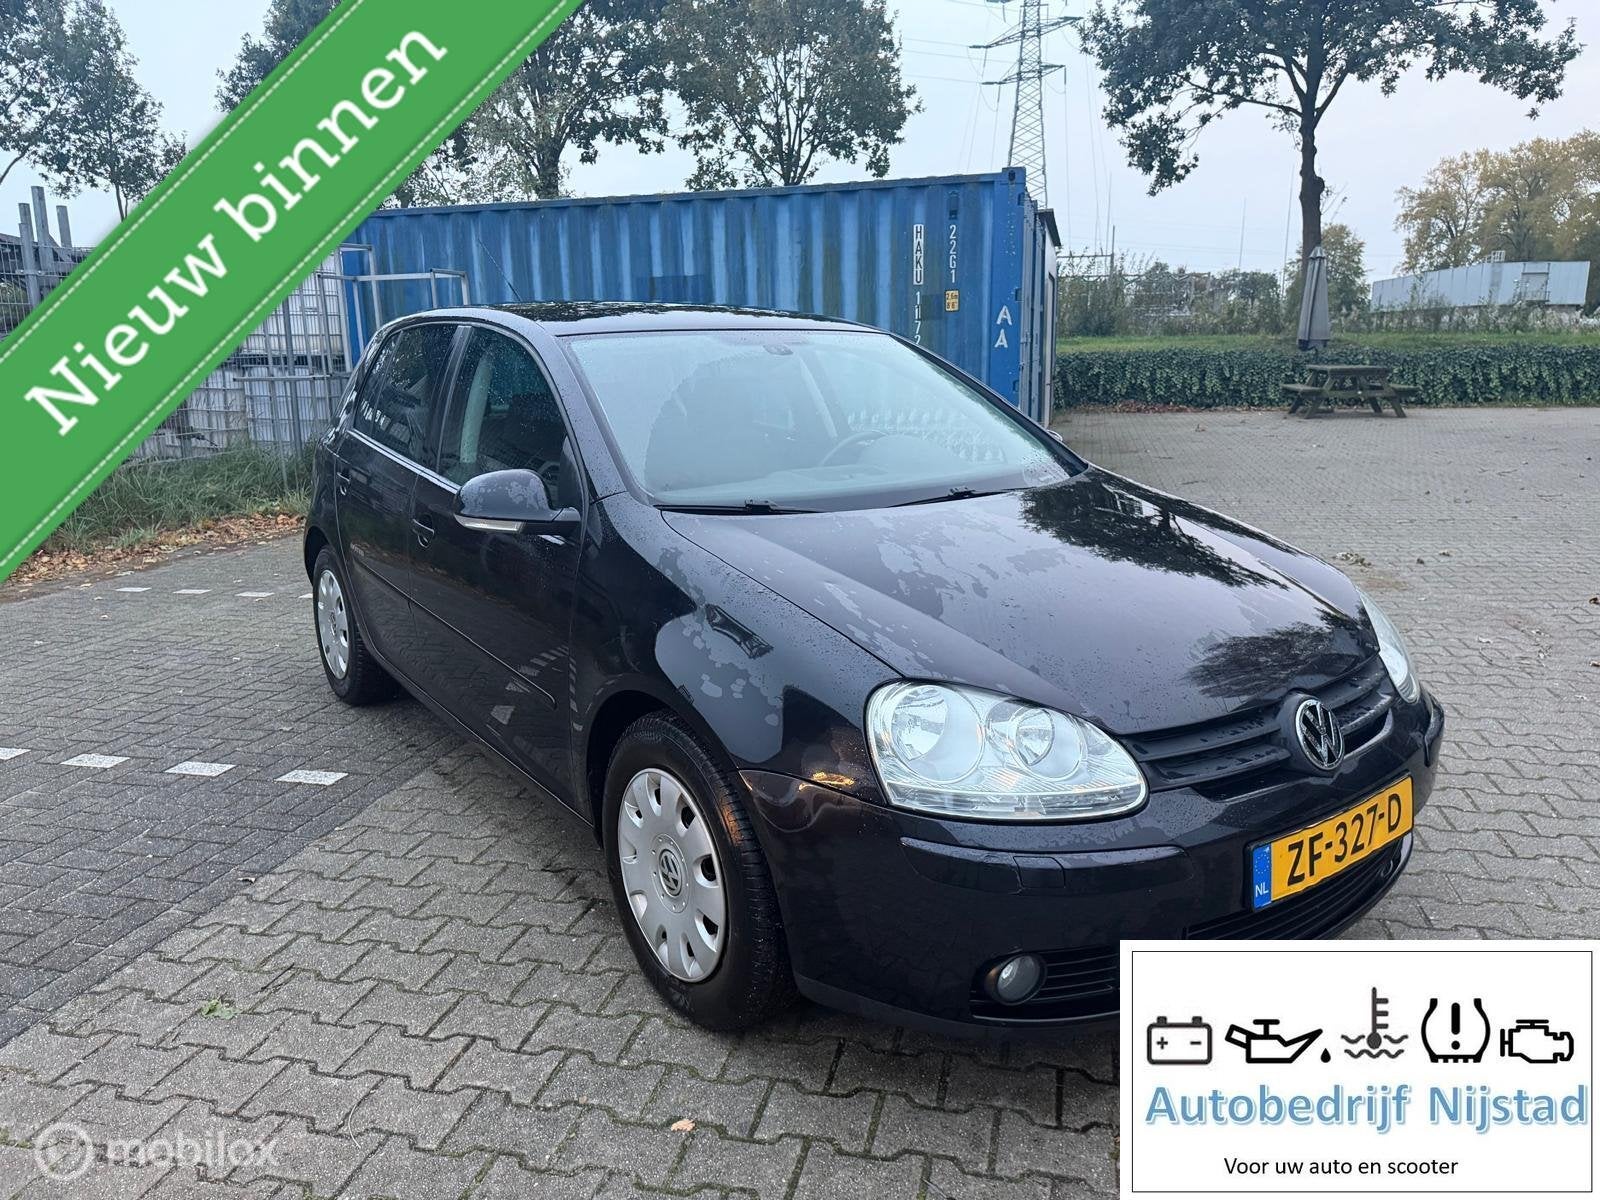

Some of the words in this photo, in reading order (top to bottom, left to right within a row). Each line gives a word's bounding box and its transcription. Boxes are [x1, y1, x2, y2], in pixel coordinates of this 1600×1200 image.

[914, 226, 923, 284] HAKU
[949, 225, 957, 283] 22G1
[1287, 794, 1401, 886] ZF-327-D
[1255, 883, 1269, 897] NL
